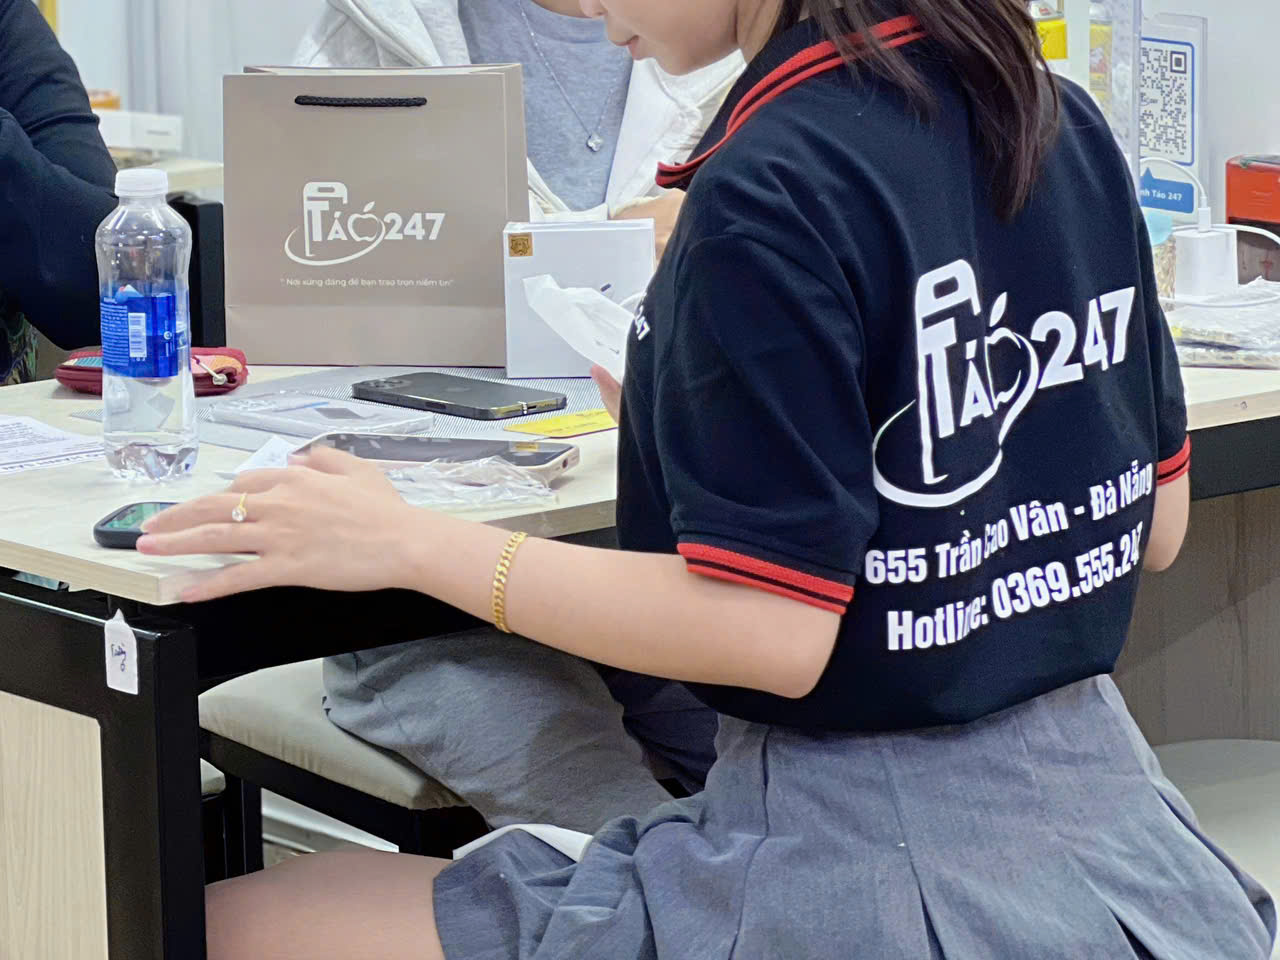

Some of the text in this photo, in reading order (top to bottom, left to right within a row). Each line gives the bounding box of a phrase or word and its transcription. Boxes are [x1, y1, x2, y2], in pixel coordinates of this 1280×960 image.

[1167, 191, 1183, 201] 247
[865, 547, 928, 584] 655
[935, 529, 983, 578] Trần
[1009, 499, 1069, 541] Vân
[1089, 479, 1117, 521] Đà
